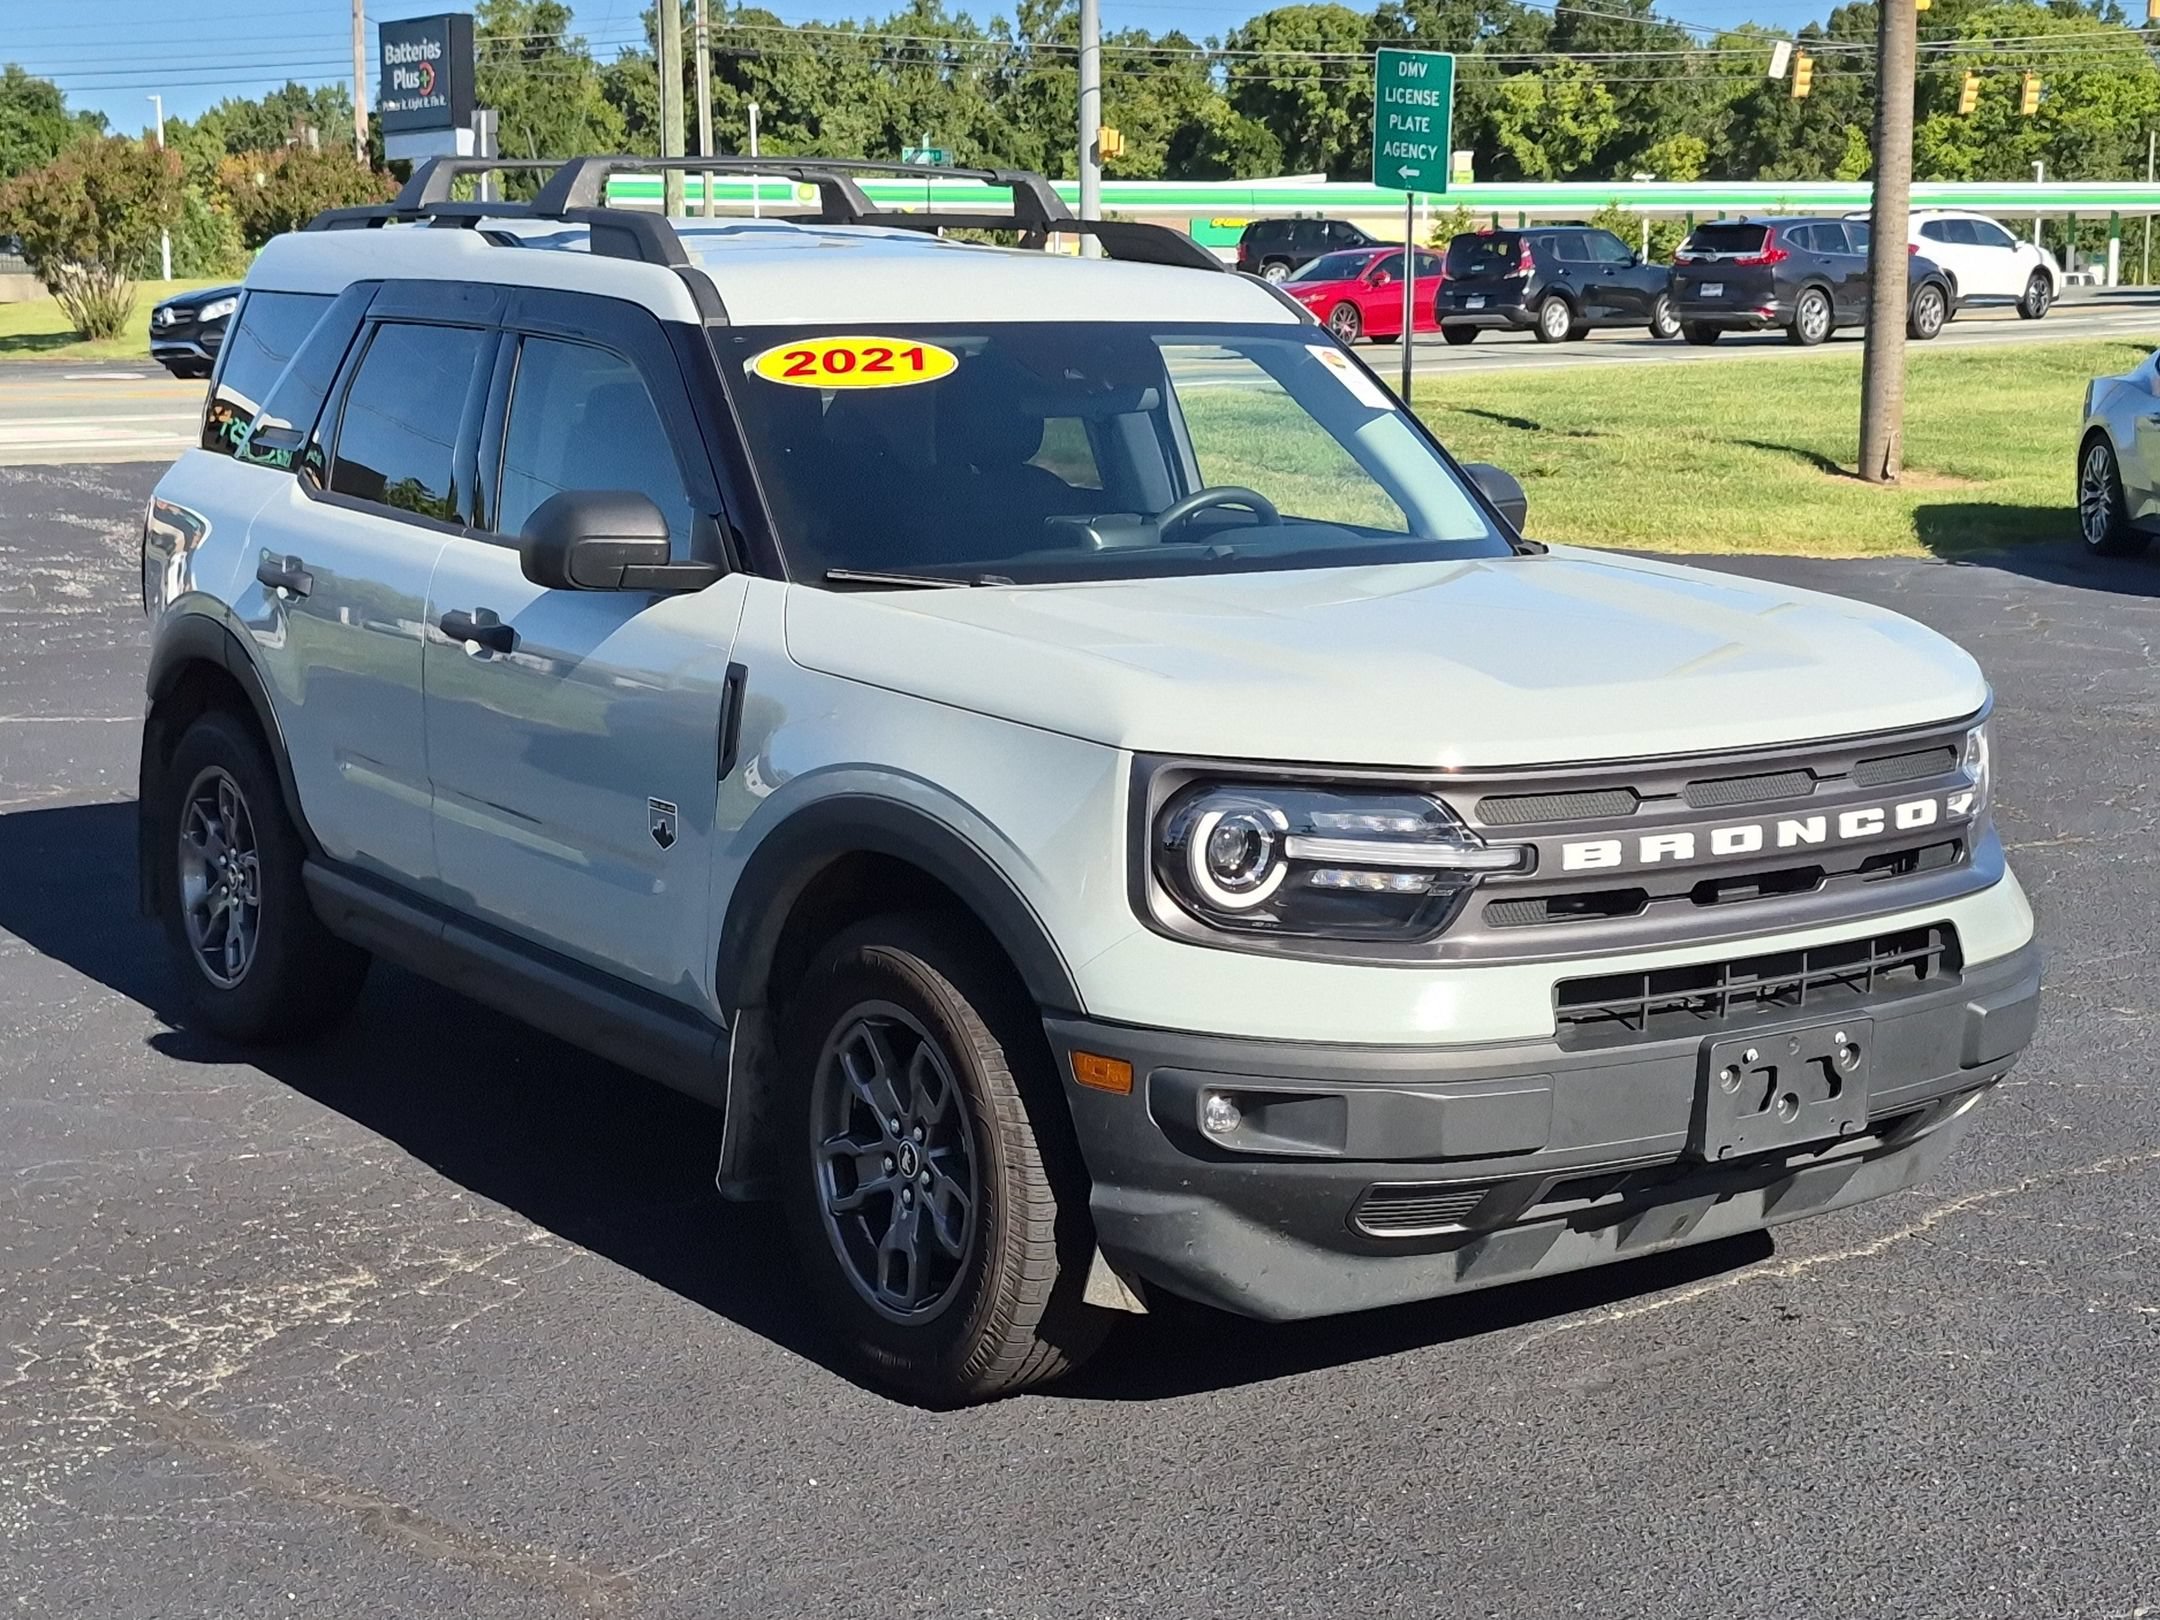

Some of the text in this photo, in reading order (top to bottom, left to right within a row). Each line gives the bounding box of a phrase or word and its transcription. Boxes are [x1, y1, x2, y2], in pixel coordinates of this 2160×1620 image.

[385, 38, 441, 65] Batteries
[394, 66, 420, 90] Plus
[1398, 61, 1428, 78] DMV
[1385, 87, 1440, 107] LICENSE
[1389, 114, 1430, 133] PLATE
[1384, 141, 1438, 161] AGENCY
[784, 347, 924, 377] 2021
[1562, 798, 1938, 872] BRONCO
